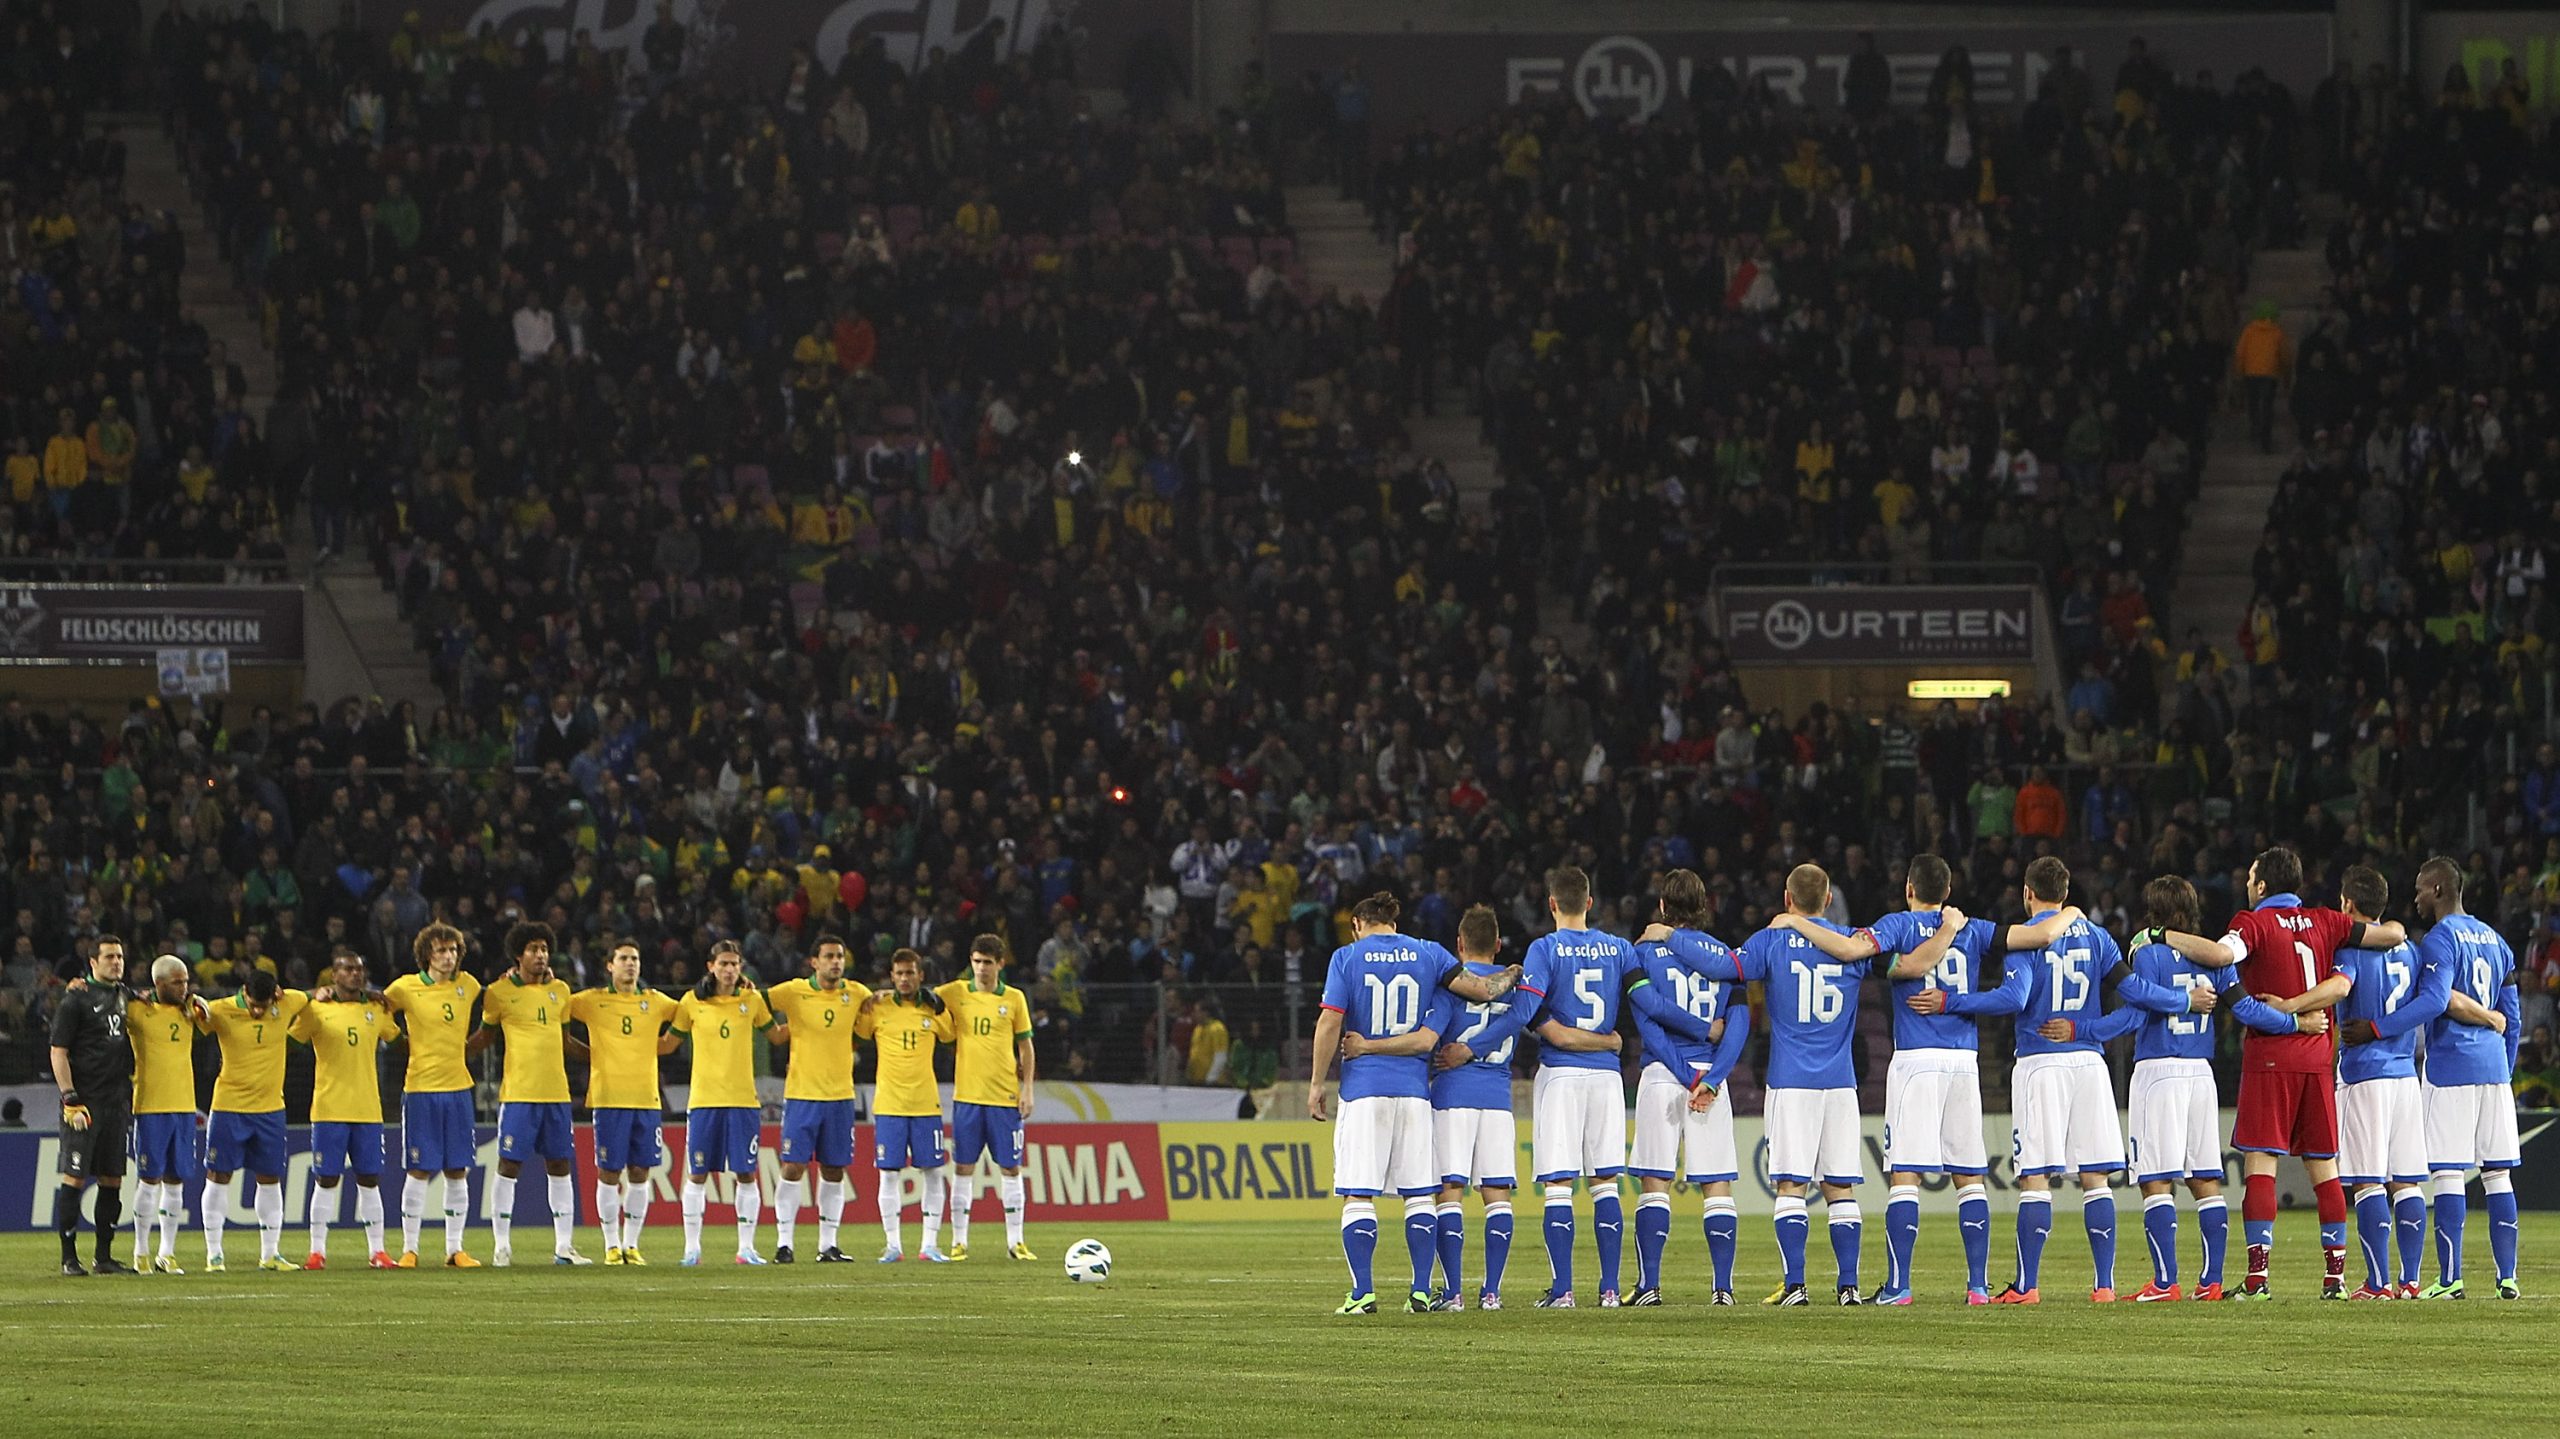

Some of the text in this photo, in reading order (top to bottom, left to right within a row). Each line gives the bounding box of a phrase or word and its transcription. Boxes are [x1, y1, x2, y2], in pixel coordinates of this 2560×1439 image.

[61, 616, 260, 643] FELDSCHLÖSSCHEN
[1365, 947, 1418, 963] osvaldo
[2294, 941, 2317, 992] 1
[2045, 948, 2091, 1012] 15
[2472, 957, 2491, 1010] 9
[1574, 968, 1605, 1032] 5
[1667, 967, 1720, 1024] 18
[1790, 961, 1844, 1024] 16
[442, 1003, 454, 1022] 3
[1364, 974, 1419, 1035] 10
[108, 1014, 121, 1036] 12
[537, 1006, 547, 1025] 4
[622, 1015, 632, 1035] 8
[824, 1009, 835, 1028] 9
[974, 1016, 991, 1035] 10
[170, 1023, 180, 1042] 2
[252, 1024, 263, 1044] 7
[347, 1027, 358, 1046] 5
[719, 1019, 730, 1039] 6
[903, 1031, 916, 1050] 11
[655, 1127, 662, 1147] 8
[749, 1134, 758, 1155] 6
[1012, 1129, 1024, 1150] 10
[1166, 1143, 1328, 1201] BRASIL
